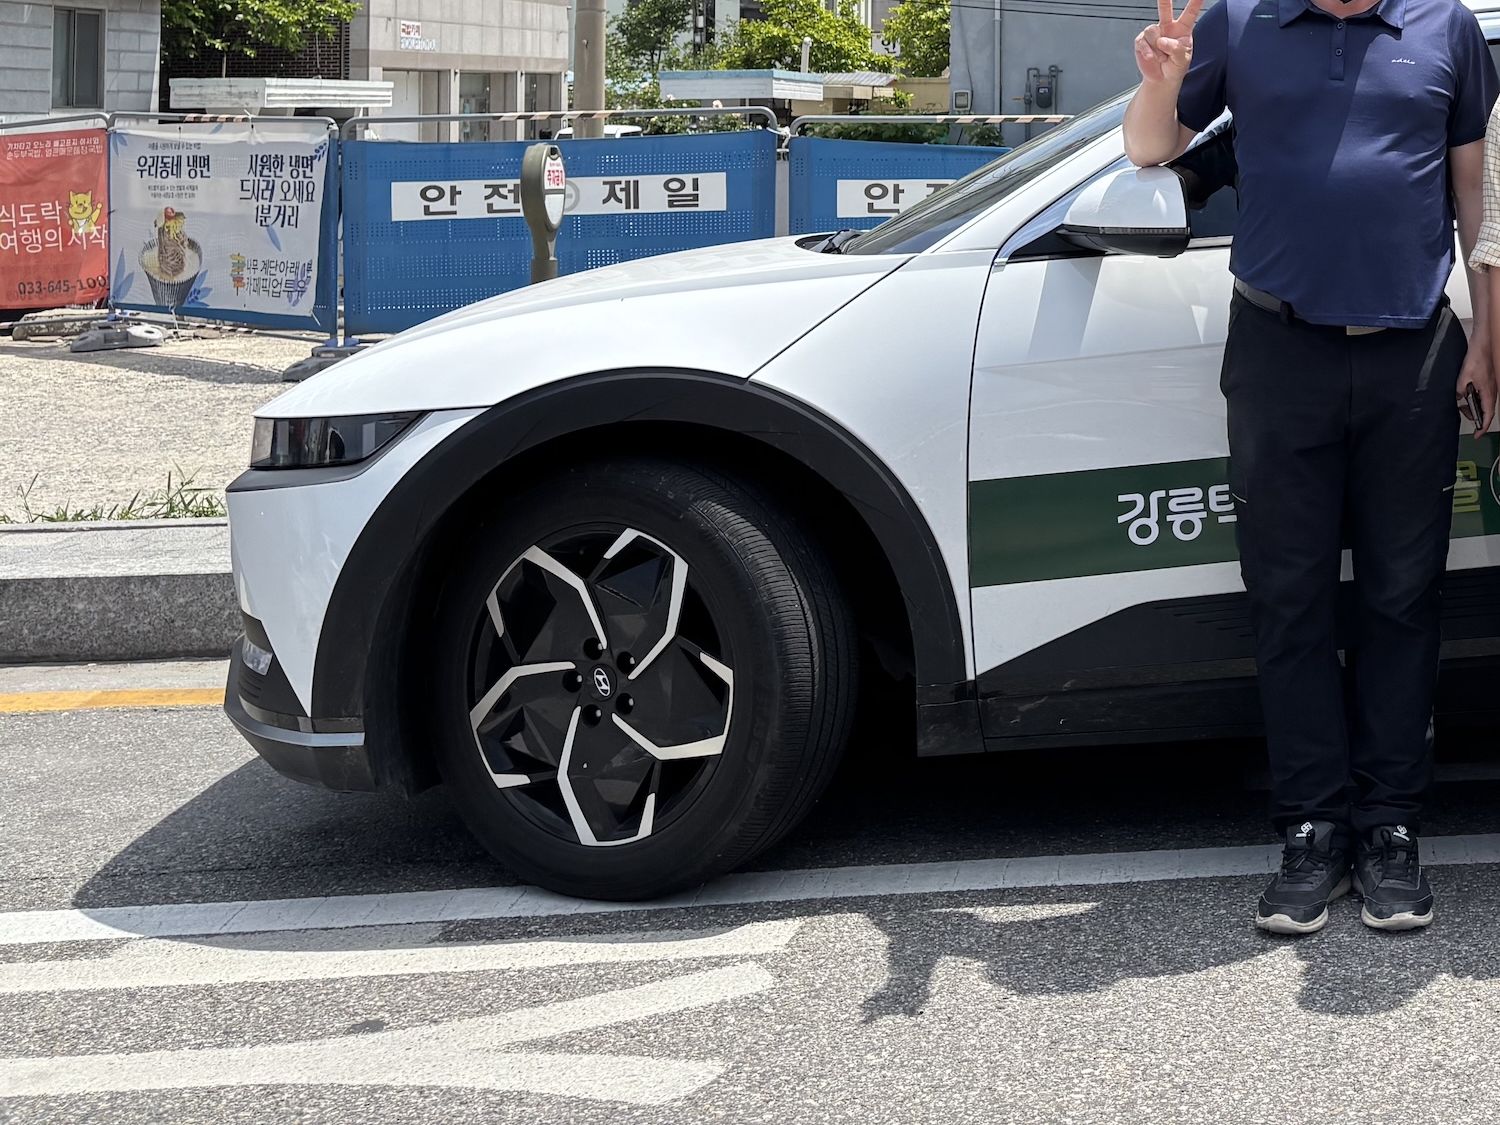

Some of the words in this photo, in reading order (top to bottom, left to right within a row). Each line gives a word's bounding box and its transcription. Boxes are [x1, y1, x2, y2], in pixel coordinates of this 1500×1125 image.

[136, 155, 182, 179] 우리동네
[186, 154, 211, 179] 냉면
[248, 154, 285, 178] 시원한
[289, 155, 314, 179] 냉면
[239, 179, 275, 202] 드시러
[280, 180, 315, 204] 오세요
[419, 183, 521, 216] 안전
[602, 177, 700, 210] 제일
[0, 200, 62, 228] 식도락
[0, 227, 62, 255] 여행의
[67, 224, 108, 250] 시작
